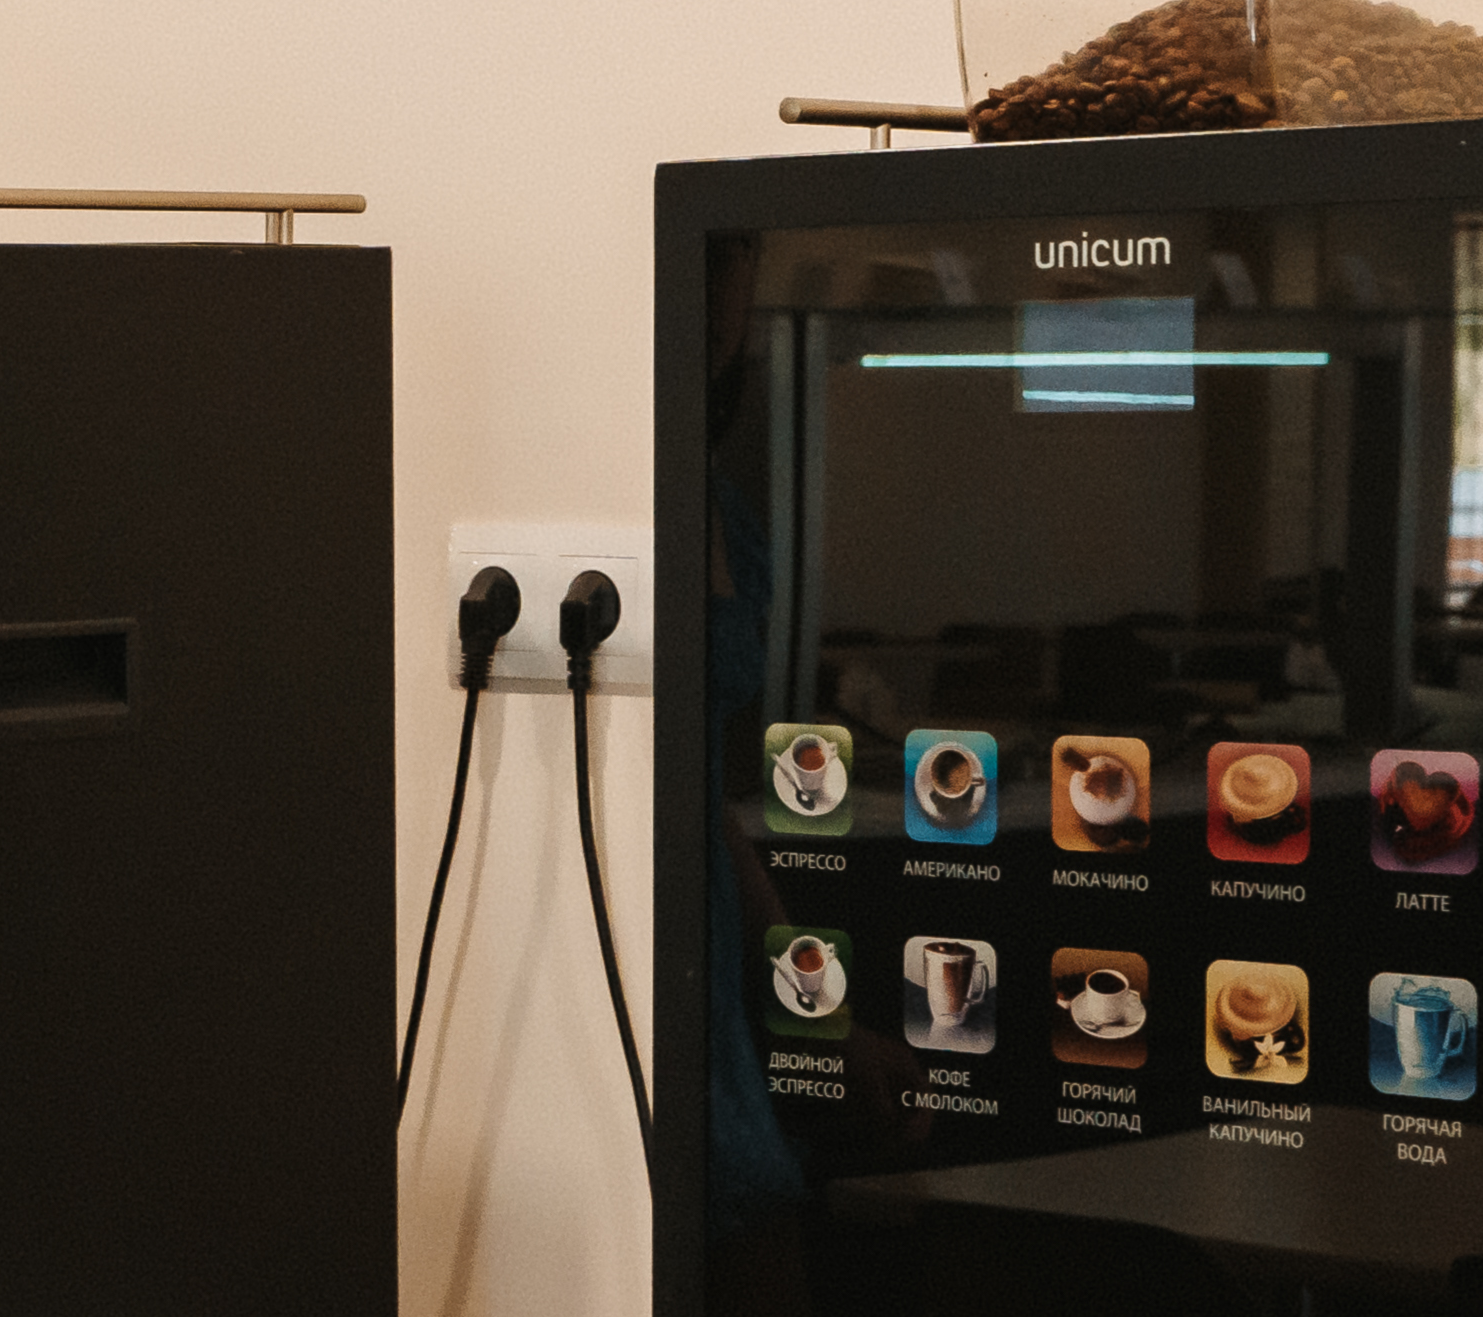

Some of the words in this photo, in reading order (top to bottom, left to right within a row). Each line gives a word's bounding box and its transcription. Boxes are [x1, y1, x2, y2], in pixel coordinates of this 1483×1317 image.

[1034, 231, 1171, 270] unicum
[770, 850, 846, 872] ЭСПРЕССО
[902, 859, 1001, 882] АМЕРИКАНО
[1052, 868, 1149, 892] МОКАЧИНО
[1210, 880, 1306, 904] КАПУЧИНО
[1395, 890, 1451, 913] ЛАТТЕ
[769, 1051, 844, 1075] ДВОЙНОЙ
[768, 1077, 845, 1100] ЭСПРЕССО
[928, 1066, 971, 1088] КОФЕ
[901, 1091, 911, 1107] С
[914, 1091, 999, 1115] МОЛОКОМ
[1061, 1079, 1137, 1104] ГОРЯЧИЙ
[1057, 1106, 1142, 1134] ШОКОЛАД
[1202, 1094, 1312, 1123] ВАНИЛЬНЫЙ
[1209, 1122, 1304, 1148] КАПУЧИНО
[1382, 1113, 1462, 1138] ГОРЯЧАЯ
[1397, 1141, 1448, 1166] ВОДА
